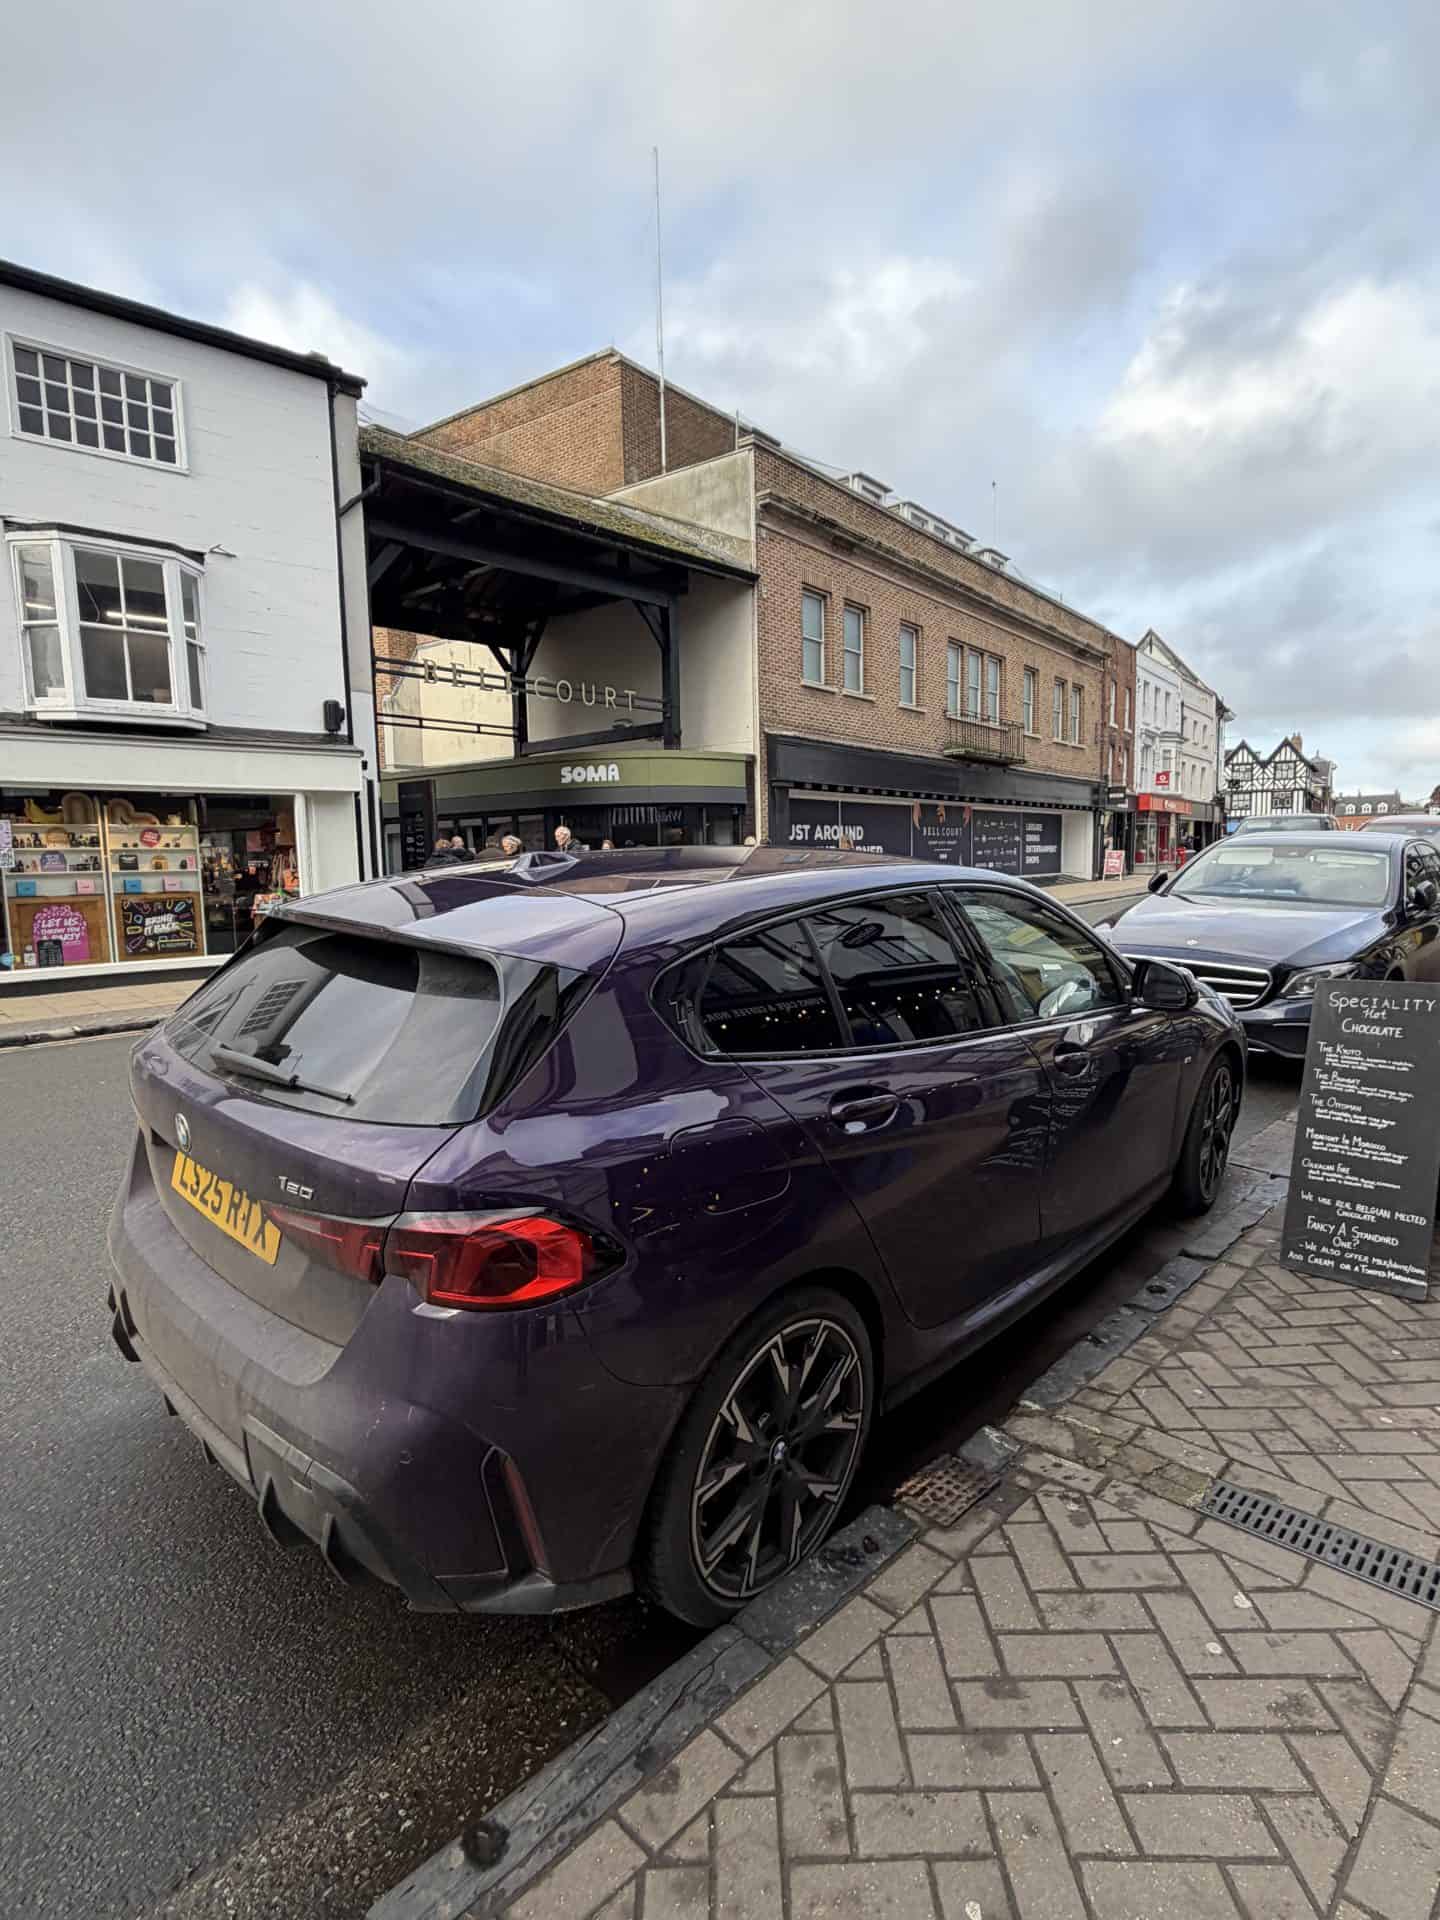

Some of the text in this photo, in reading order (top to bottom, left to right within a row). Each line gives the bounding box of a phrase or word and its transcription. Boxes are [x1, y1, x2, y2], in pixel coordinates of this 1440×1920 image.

[423, 658, 636, 711] BELL COURT
[561, 764, 620, 784] SOMA
[814, 824, 864, 841] AROUND
[278, 1175, 314, 1201] 120
[1337, 1221, 1347, 1236] A
